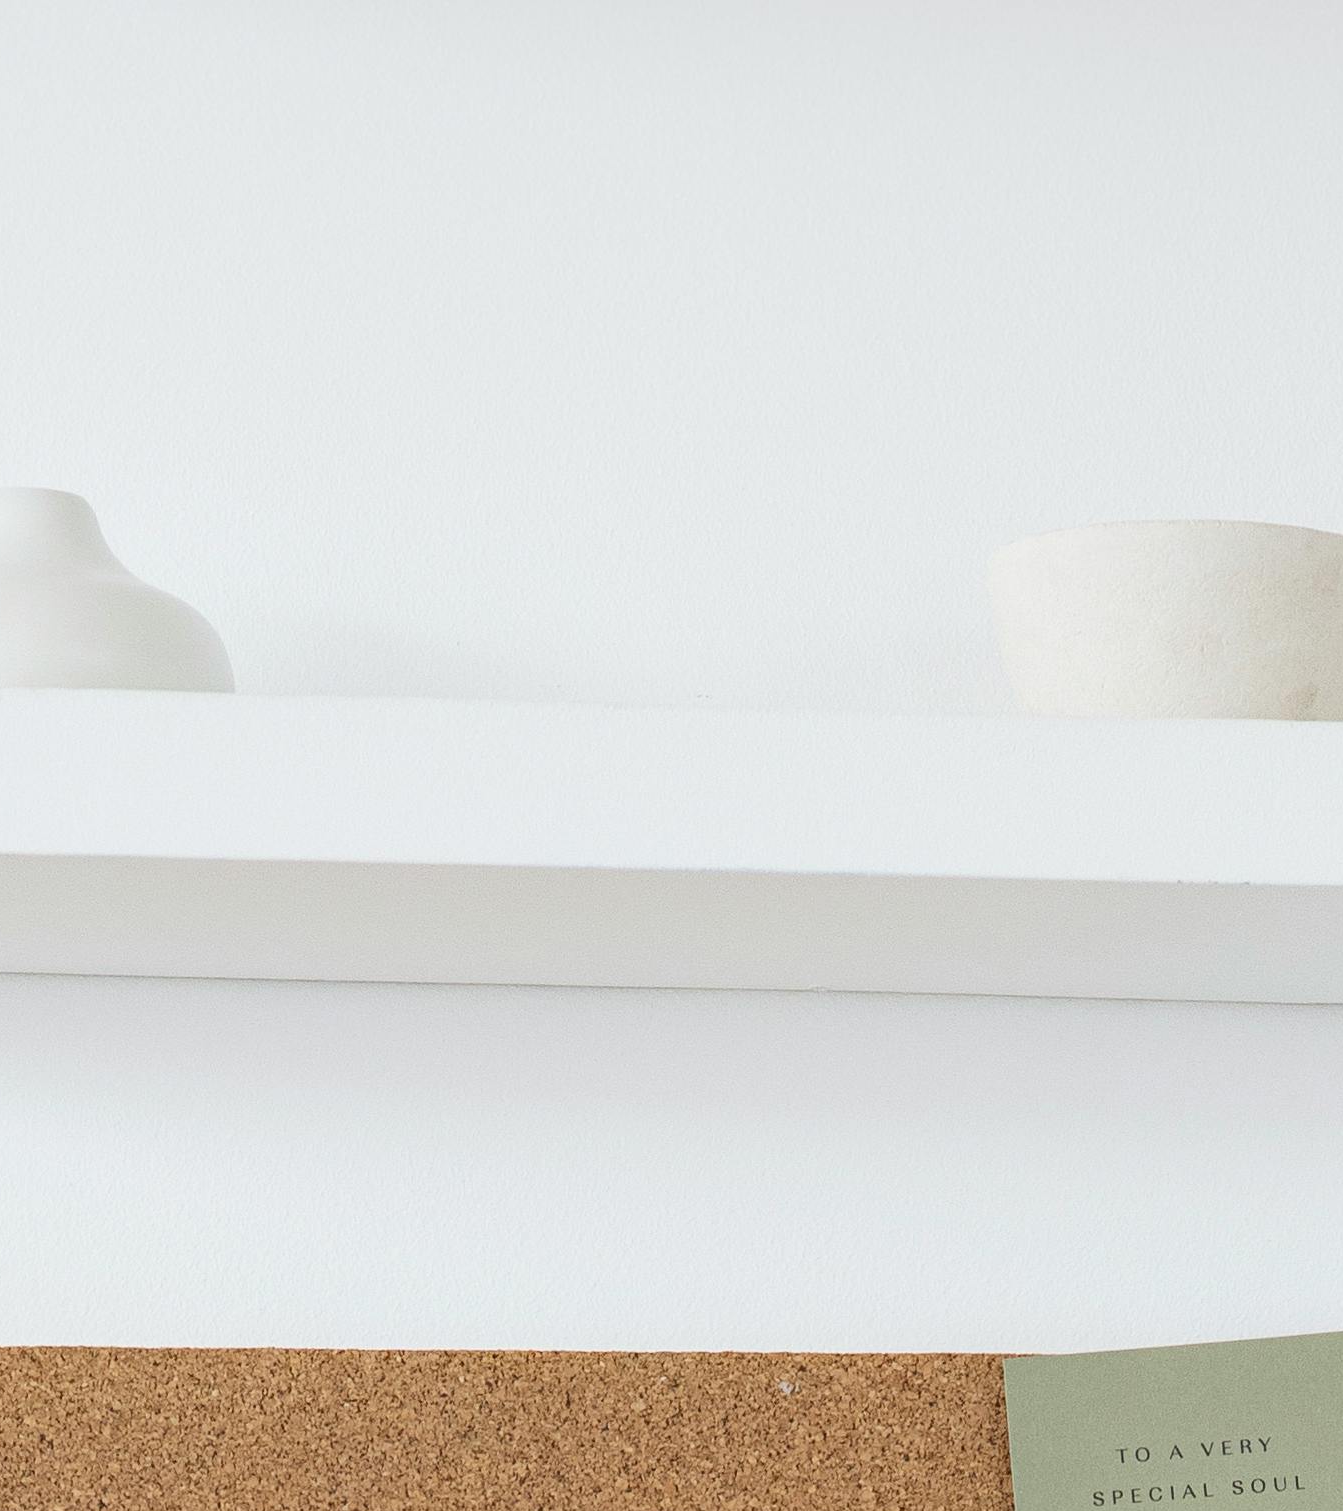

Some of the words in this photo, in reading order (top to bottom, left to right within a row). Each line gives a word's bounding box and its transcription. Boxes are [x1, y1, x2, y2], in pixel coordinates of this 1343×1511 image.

[1115, 1446, 1151, 1464] TO
[1169, 1444, 1184, 1461] A
[1200, 1436, 1272, 1457] VERY
[1092, 1482, 1214, 1507] SPECIAL
[1231, 1475, 1306, 1496] SOUL
